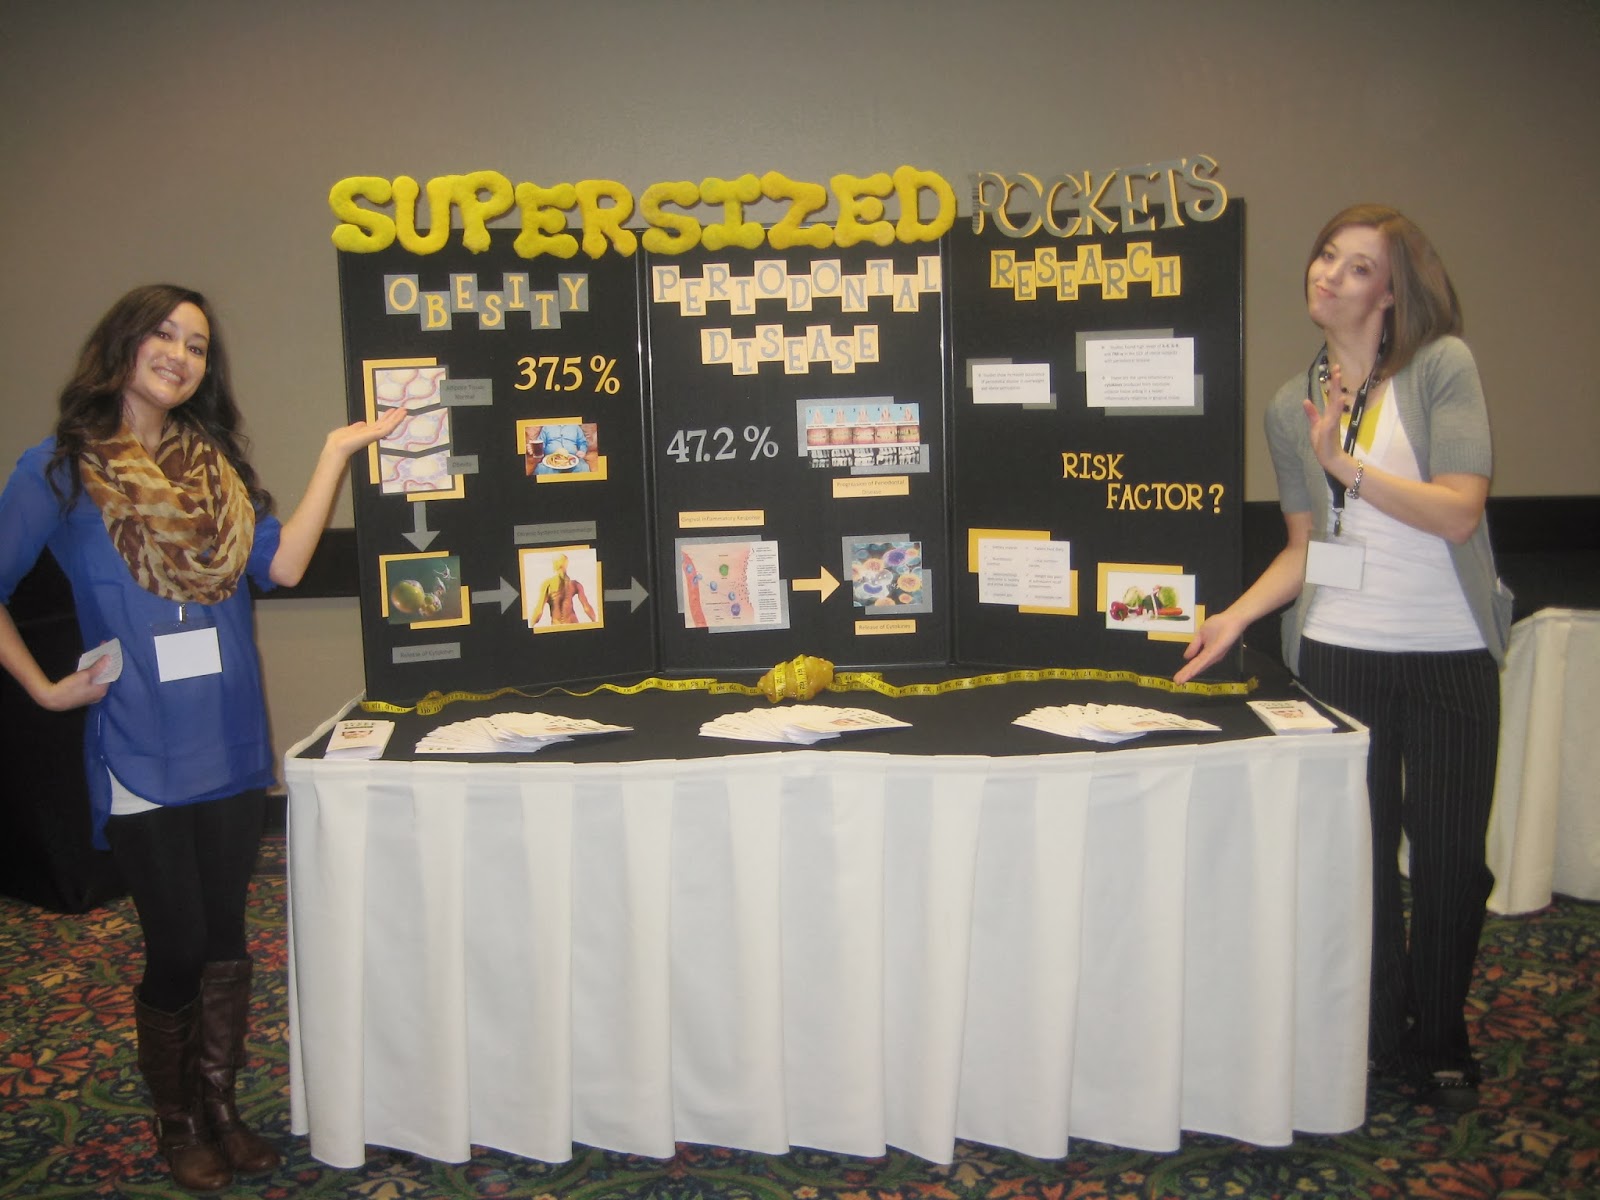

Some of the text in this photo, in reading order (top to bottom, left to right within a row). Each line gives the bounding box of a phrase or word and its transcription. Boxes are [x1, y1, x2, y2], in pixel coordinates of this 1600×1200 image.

[329, 154, 1228, 259] SUPERSIZED POCKETS
[656, 258, 938, 313] PERIODONTAL
[994, 245, 1178, 299] RESEARCH
[388, 275, 586, 328] OBESITY
[513, 354, 621, 395] 37.5 %
[707, 327, 876, 373] DISEASE
[666, 425, 779, 463] 47.2 %
[1061, 452, 1125, 480] RISK
